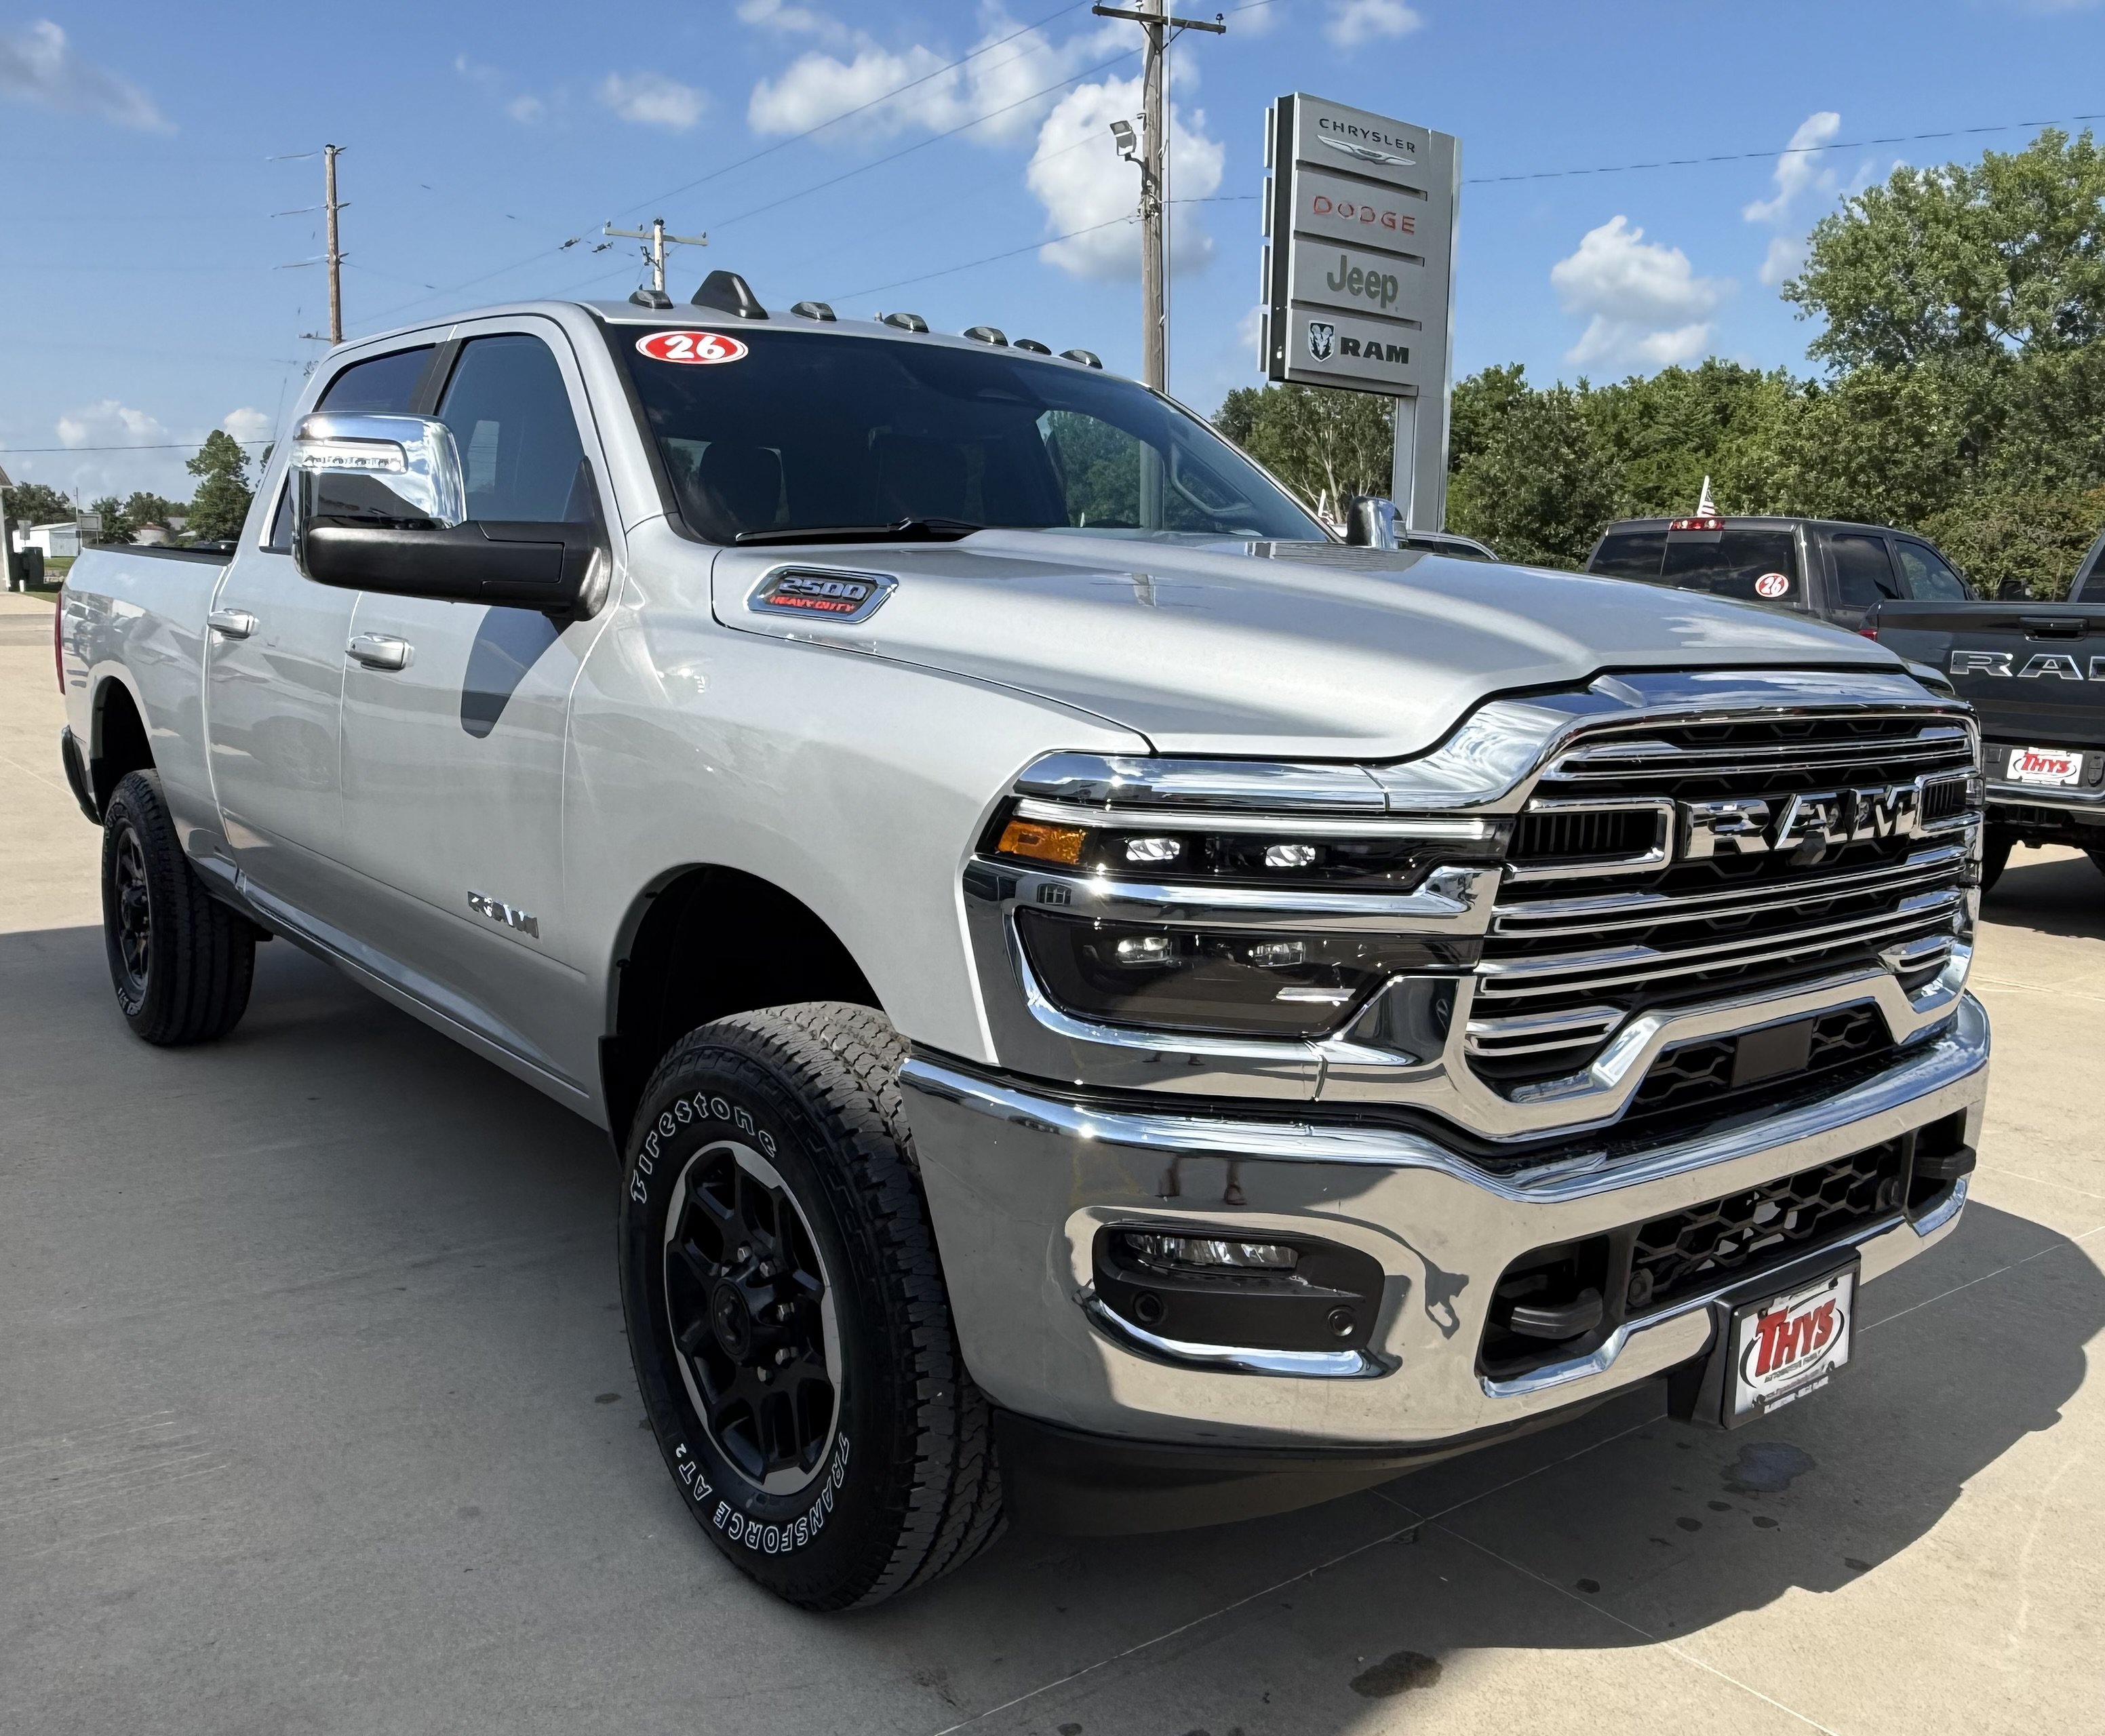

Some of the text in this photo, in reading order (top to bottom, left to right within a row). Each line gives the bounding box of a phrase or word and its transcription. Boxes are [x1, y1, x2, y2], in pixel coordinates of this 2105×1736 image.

[1318, 117, 1416, 153] CHRYSLER
[1313, 195, 1416, 235] DODGE
[1326, 254, 1398, 309] Jeep
[664, 334, 726, 359] 26
[1340, 336, 1409, 364] RAM
[779, 576, 867, 601] 2500
[1760, 576, 1783, 596] 26
[1950, 650, 2105, 682] RA
[1679, 784, 1919, 859] RAM
[630, 1091, 777, 1204] Firestone
[1754, 1298, 1836, 1378] THYS
[713, 1432, 850, 1554] TRANSFORCE
